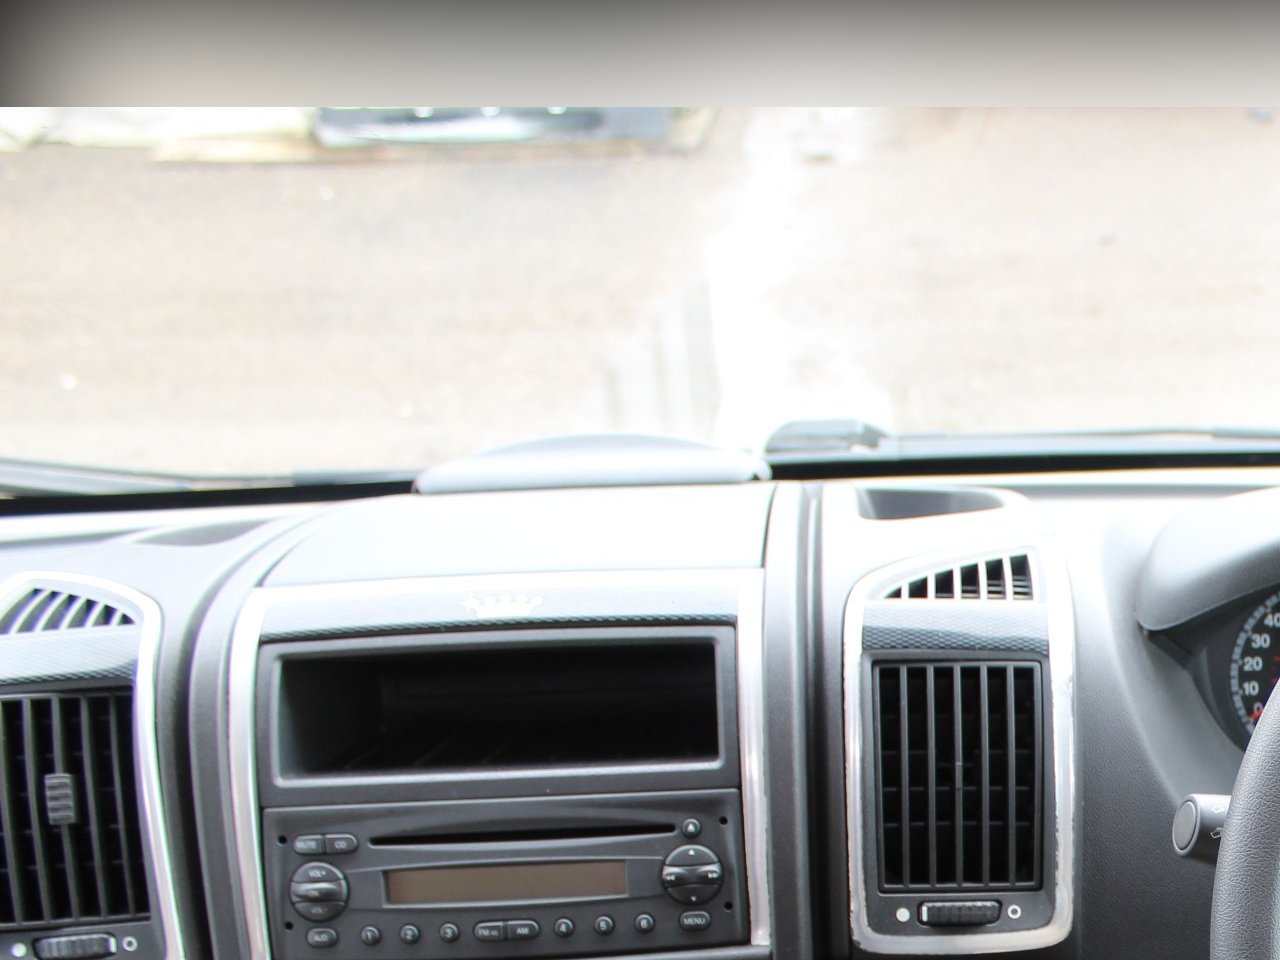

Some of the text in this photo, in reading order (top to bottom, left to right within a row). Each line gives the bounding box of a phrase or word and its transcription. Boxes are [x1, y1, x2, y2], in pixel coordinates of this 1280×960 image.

[1251, 634, 1271, 649] 30
[1243, 656, 1263, 672] 20
[1242, 681, 1260, 696] 10
[334, 841, 348, 850] CD
[600, 921, 607, 931] 5
[640, 919, 648, 929] 6
[683, 917, 706, 926] MENU
[444, 928, 452, 938] 3
[516, 927, 529, 935] AM
[559, 924, 567, 933] 4
[404, 930, 412, 940] 2
